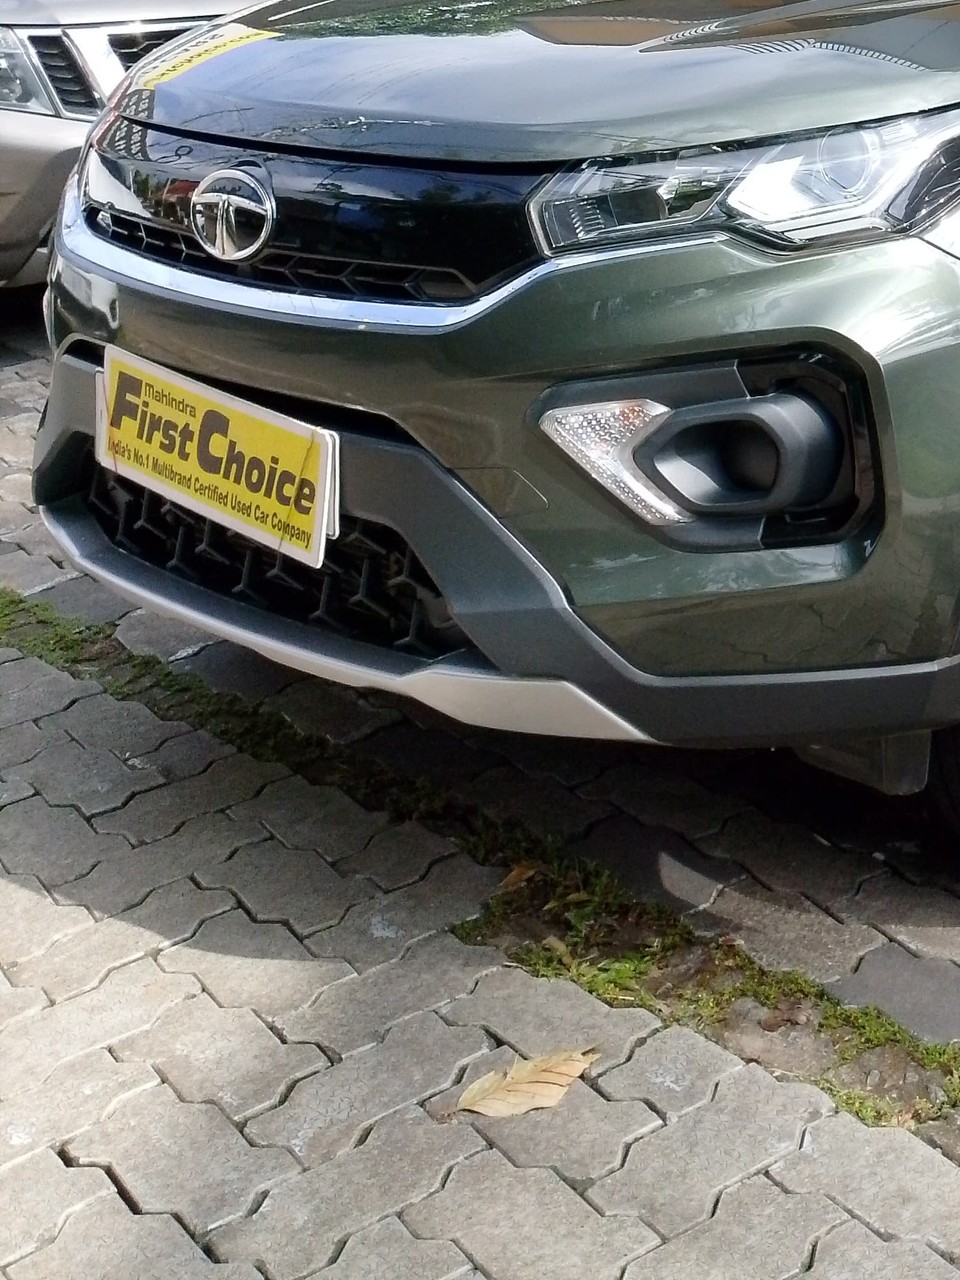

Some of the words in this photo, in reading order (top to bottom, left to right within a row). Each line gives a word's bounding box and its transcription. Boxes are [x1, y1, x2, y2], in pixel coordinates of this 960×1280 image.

[110, 370, 195, 462] First
[197, 409, 316, 516] Choice
[151, 456, 192, 490] Multibrand
[193, 477, 229, 507] Certified
[230, 493, 252, 518] Used
[253, 504, 269, 526] Car
[271, 512, 312, 549] Company
